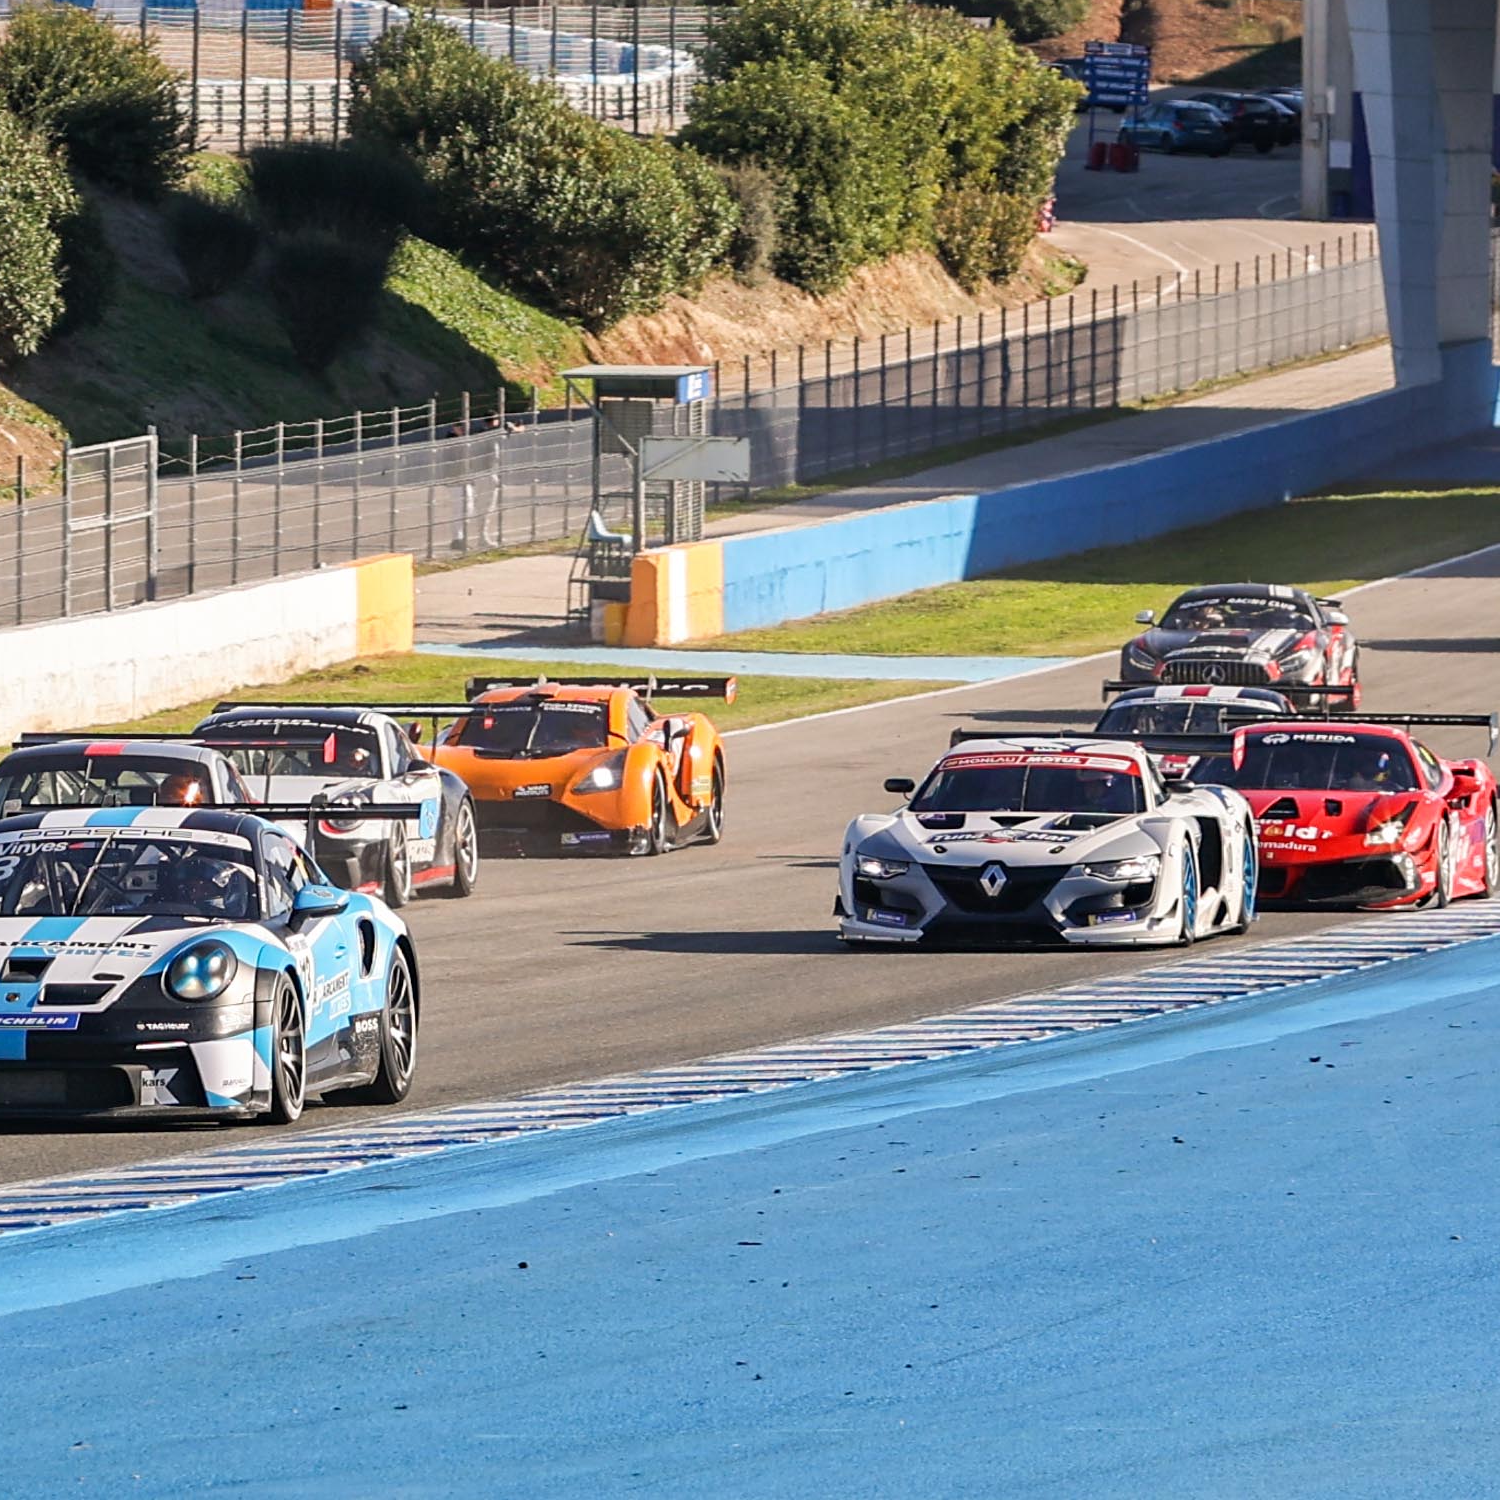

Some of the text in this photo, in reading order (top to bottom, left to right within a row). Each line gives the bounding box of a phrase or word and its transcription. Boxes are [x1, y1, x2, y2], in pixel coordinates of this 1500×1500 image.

[1227, 597, 1268, 606] RACING
[1268, 600, 1297, 611] CLUB
[1292, 734, 1357, 744] MERIDA
[958, 757, 1016, 766] MONLAU
[1026, 755, 1082, 765] MOTUL
[18, 828, 193, 839] PORSCHE
[1026, 832, 1071, 843] Mar
[45, 948, 154, 958] VINYES
[355, 1017, 379, 1034] BOSS
[142, 1077, 166, 1087] kars
